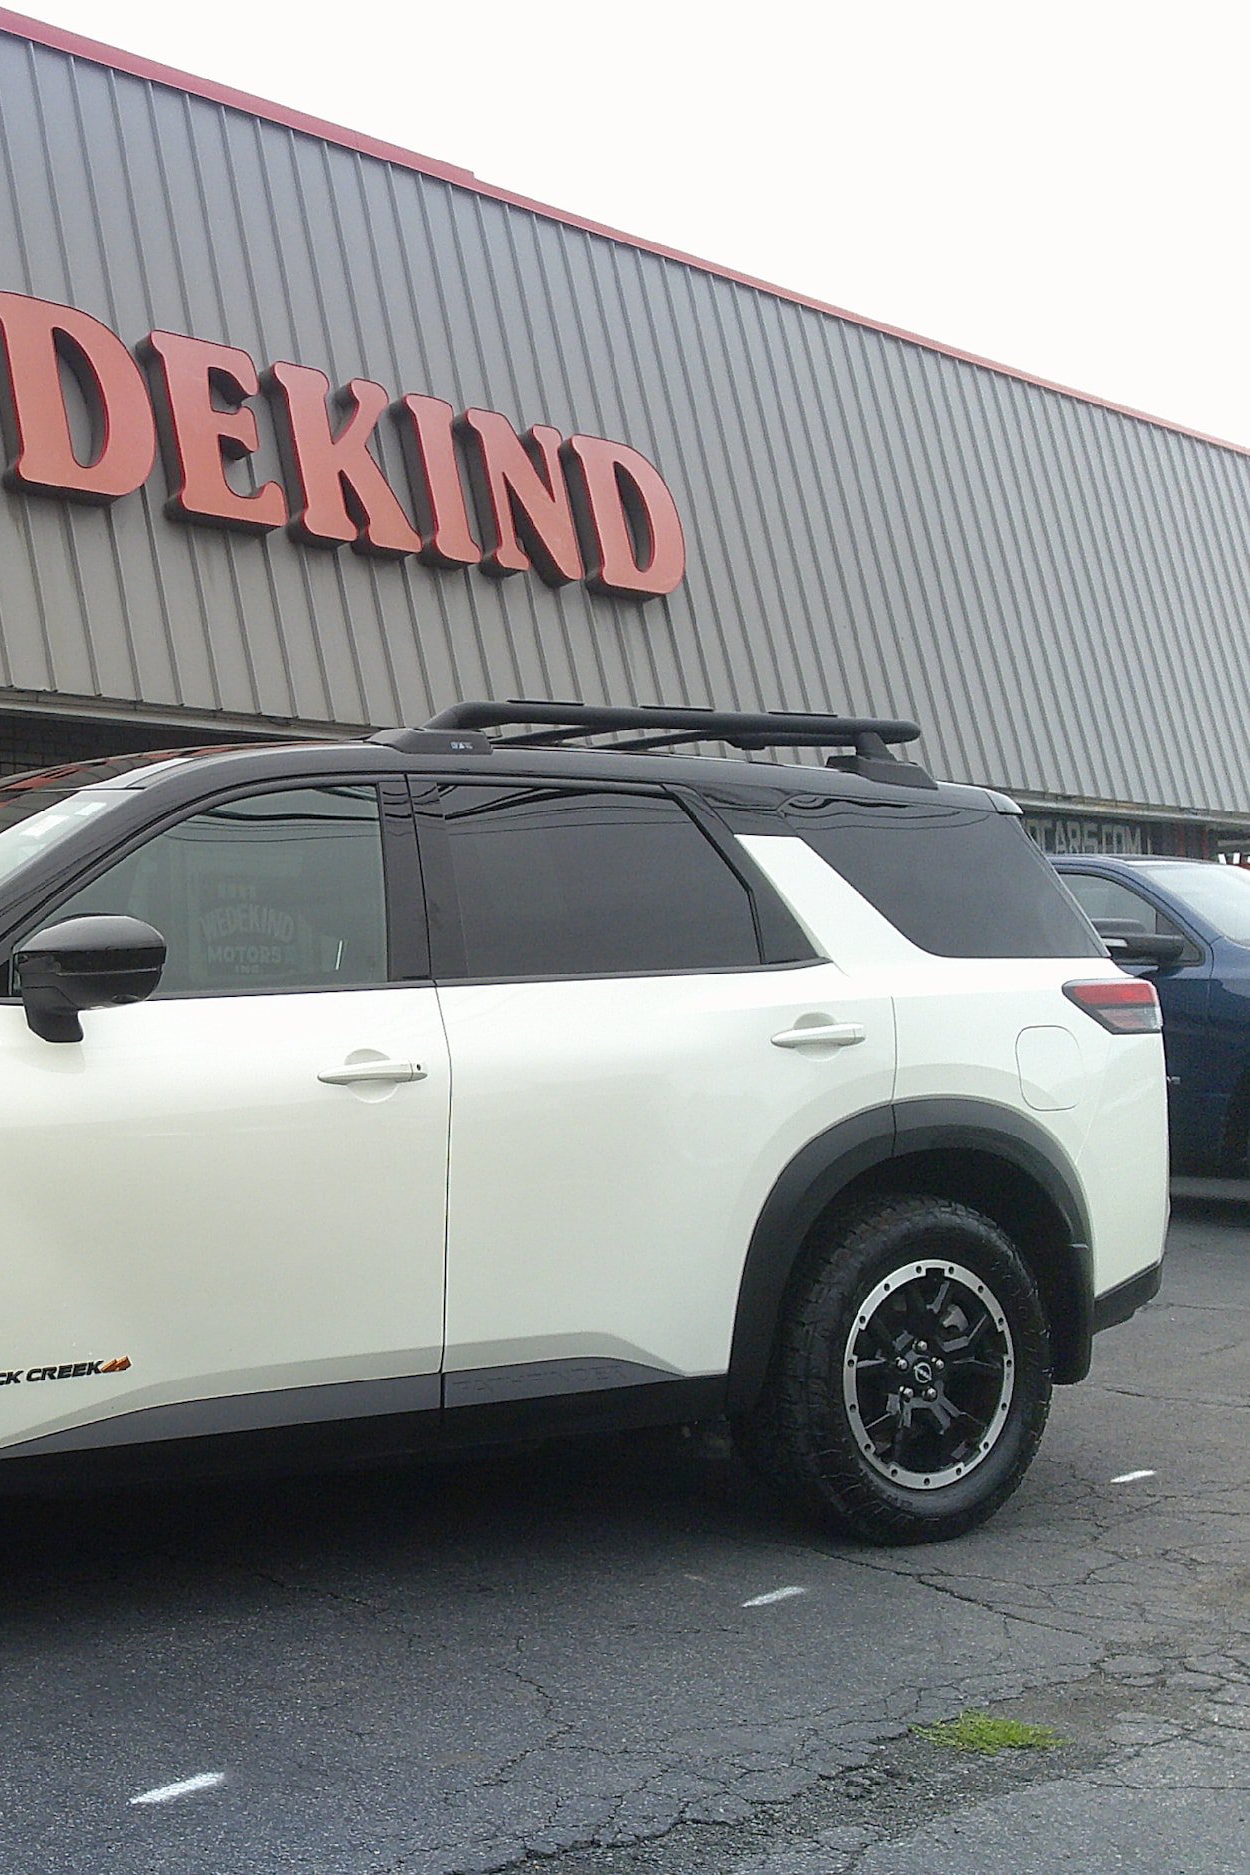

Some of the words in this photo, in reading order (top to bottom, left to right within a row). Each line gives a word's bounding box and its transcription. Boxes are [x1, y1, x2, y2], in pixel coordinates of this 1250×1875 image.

[198, 903, 294, 942] WEDEKIND
[207, 945, 282, 964] MOTORS
[26, 1359, 104, 1383] CREEK
